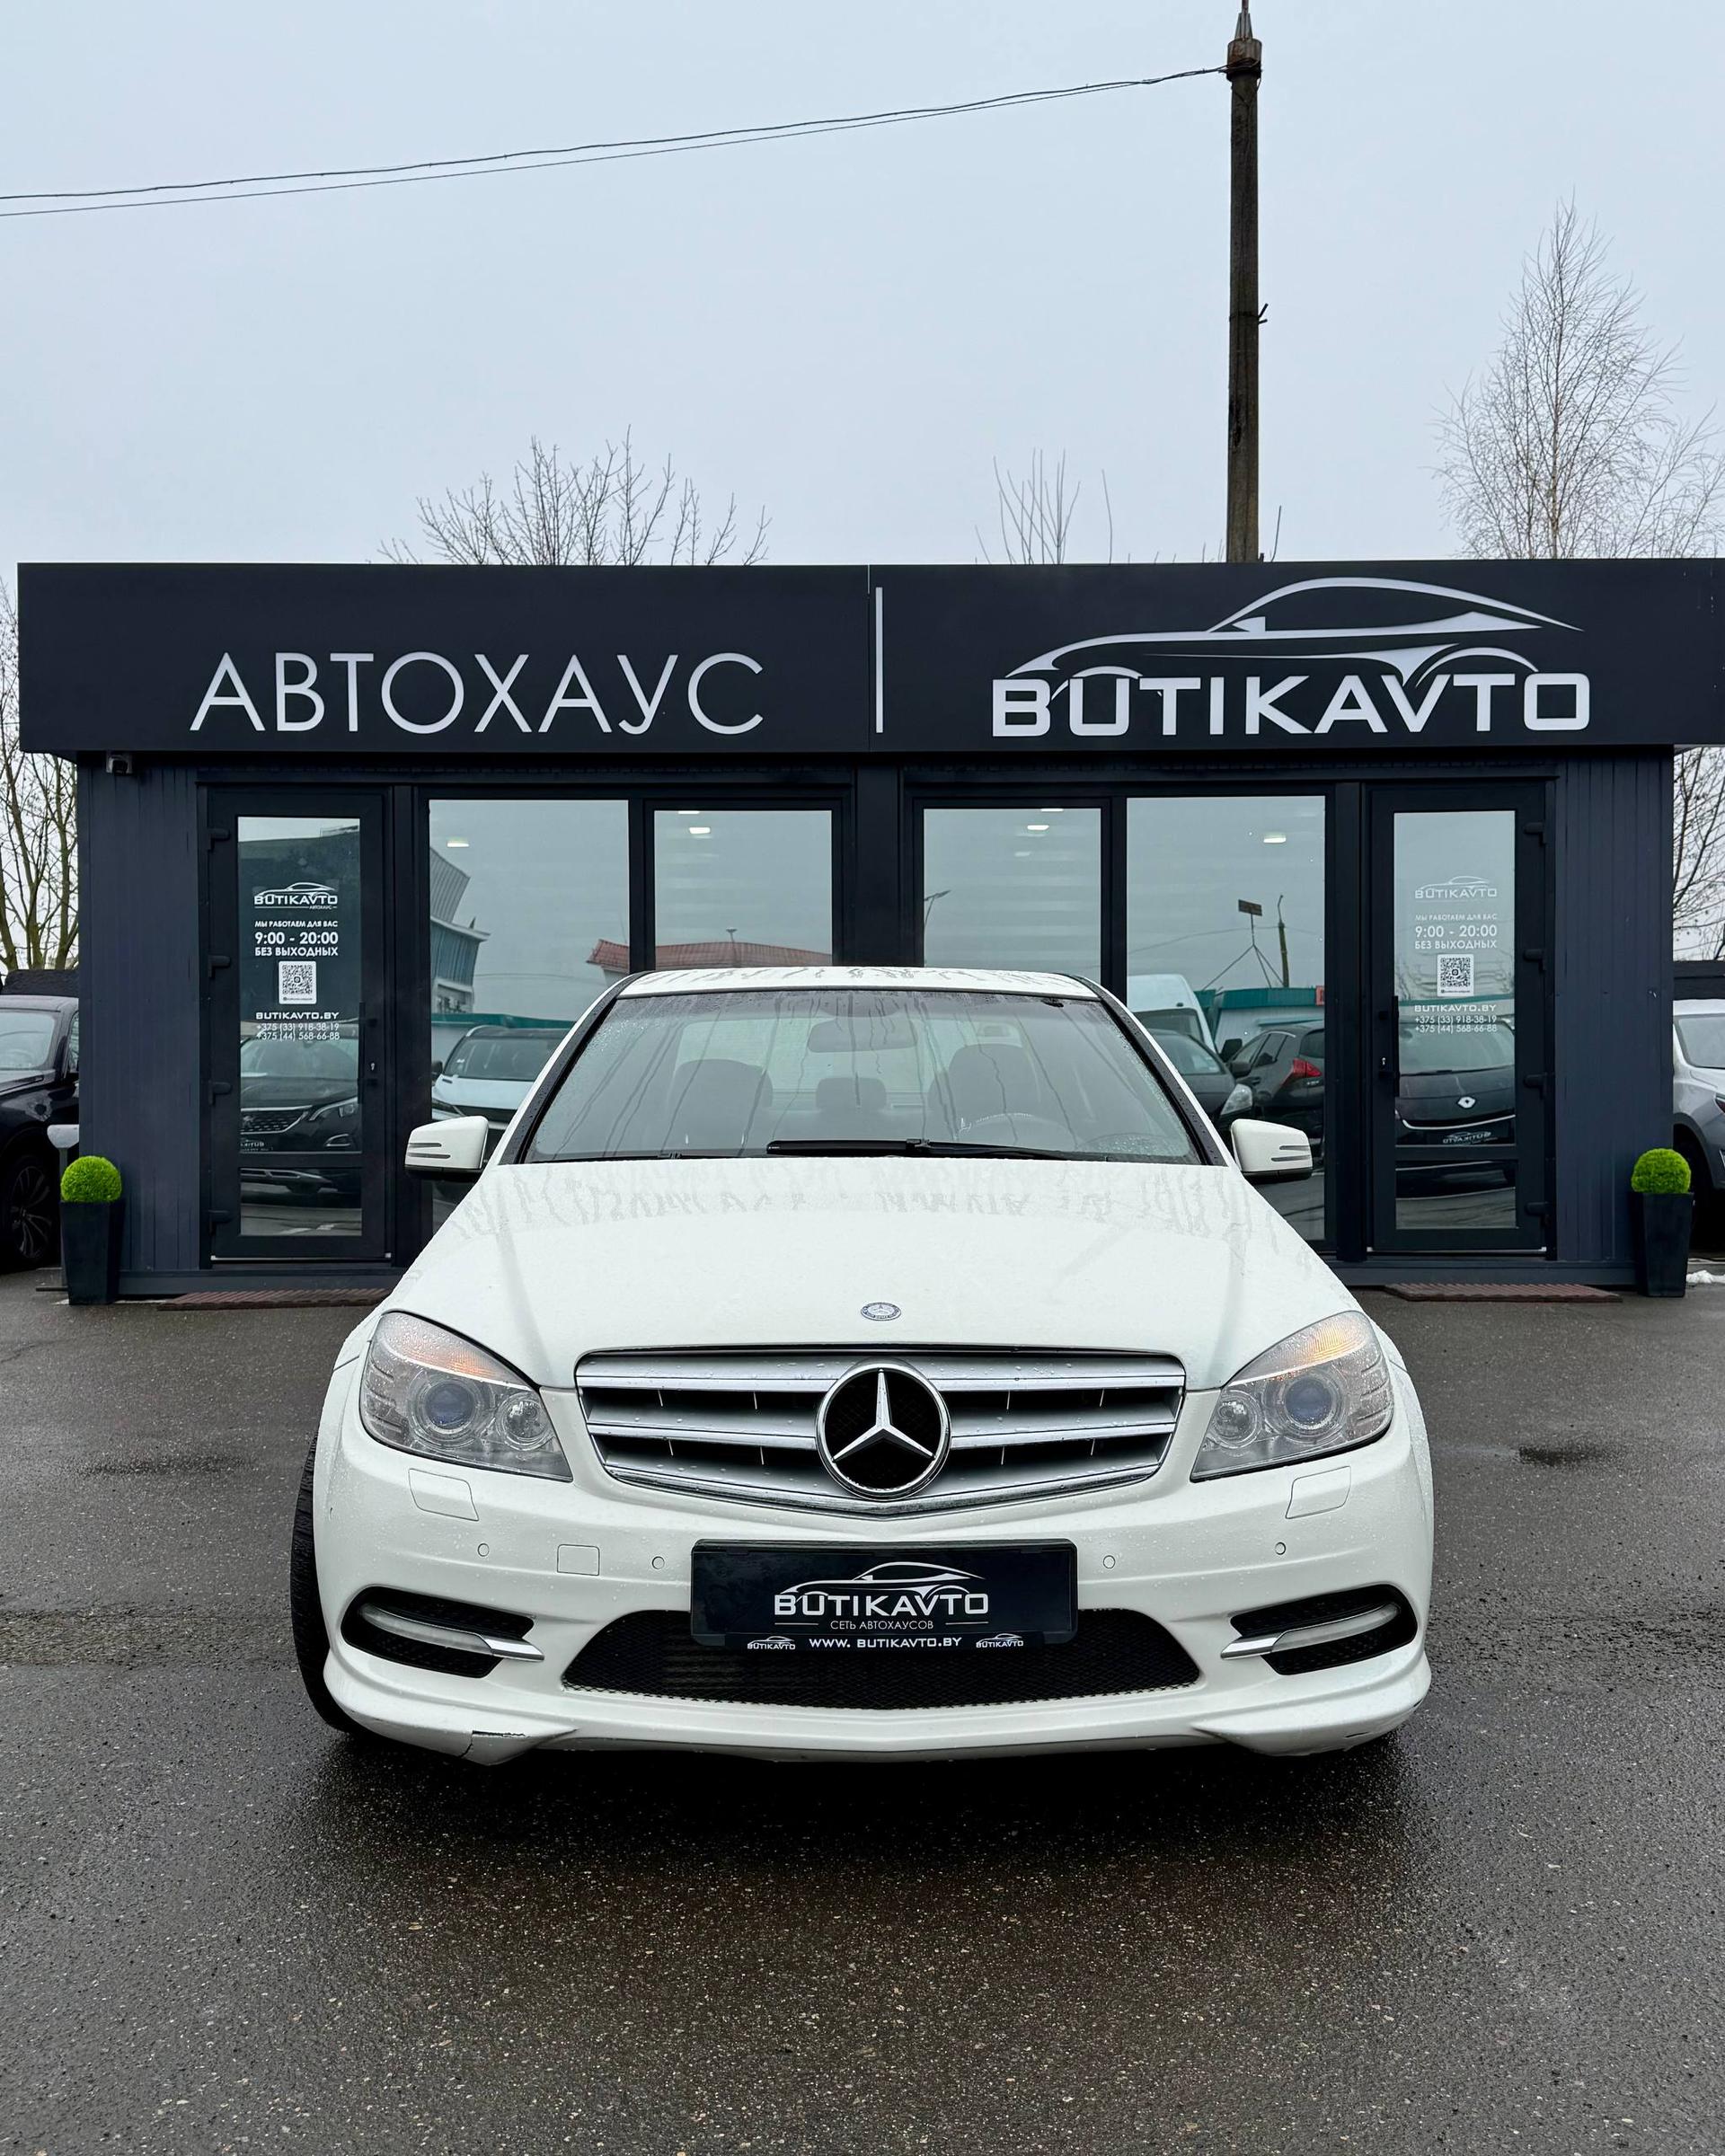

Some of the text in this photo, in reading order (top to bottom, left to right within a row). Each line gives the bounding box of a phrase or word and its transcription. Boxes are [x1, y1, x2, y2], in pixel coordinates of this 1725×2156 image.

[190, 650, 764, 735] АВТОХАУС
[993, 672, 1590, 738] BUTIKAVTO
[1414, 888, 1498, 899] BUTIKAVTO
[253, 895, 339, 906] BUTIKAVTO
[254, 920, 339, 928] МЫ РАБОТАЕМ ДЛЯ ВАС
[1415, 925, 1444, 938] 9:00
[1459, 924, 1497, 937] 20:00
[254, 932, 285, 944] 9:00
[299, 932, 339, 944] 20:00
[1414, 940, 1497, 950] БЕЗ ВЫХОДНЫХ
[254, 947, 339, 958] БЕЗ ВЫХОДНЫХ
[1414, 1004, 1497, 1012] BUTIKAVTO.BY
[255, 1012, 340, 1020] BUTIKAVTO.BY
[1415, 1015, 1497, 1025] +375 (33) 918-38-19
[256, 1022, 340, 1032] +375 (33) 918-38-19
[1415, 1024, 1498, 1034] +375 (44) 568-66-88
[256, 1031, 340, 1041] +375 (44) 568-66-88
[774, 1594, 989, 1616] BUTIKAVTO
[830, 1620, 933, 1630] СЕТЬ АВТОХАУСОВ
[747, 1642, 796, 1650] BUTIKAVTO
[856, 1638, 962, 1648] BUTIKAVTO.BY
[976, 1640, 1024, 1648] BUTIKAVTO
